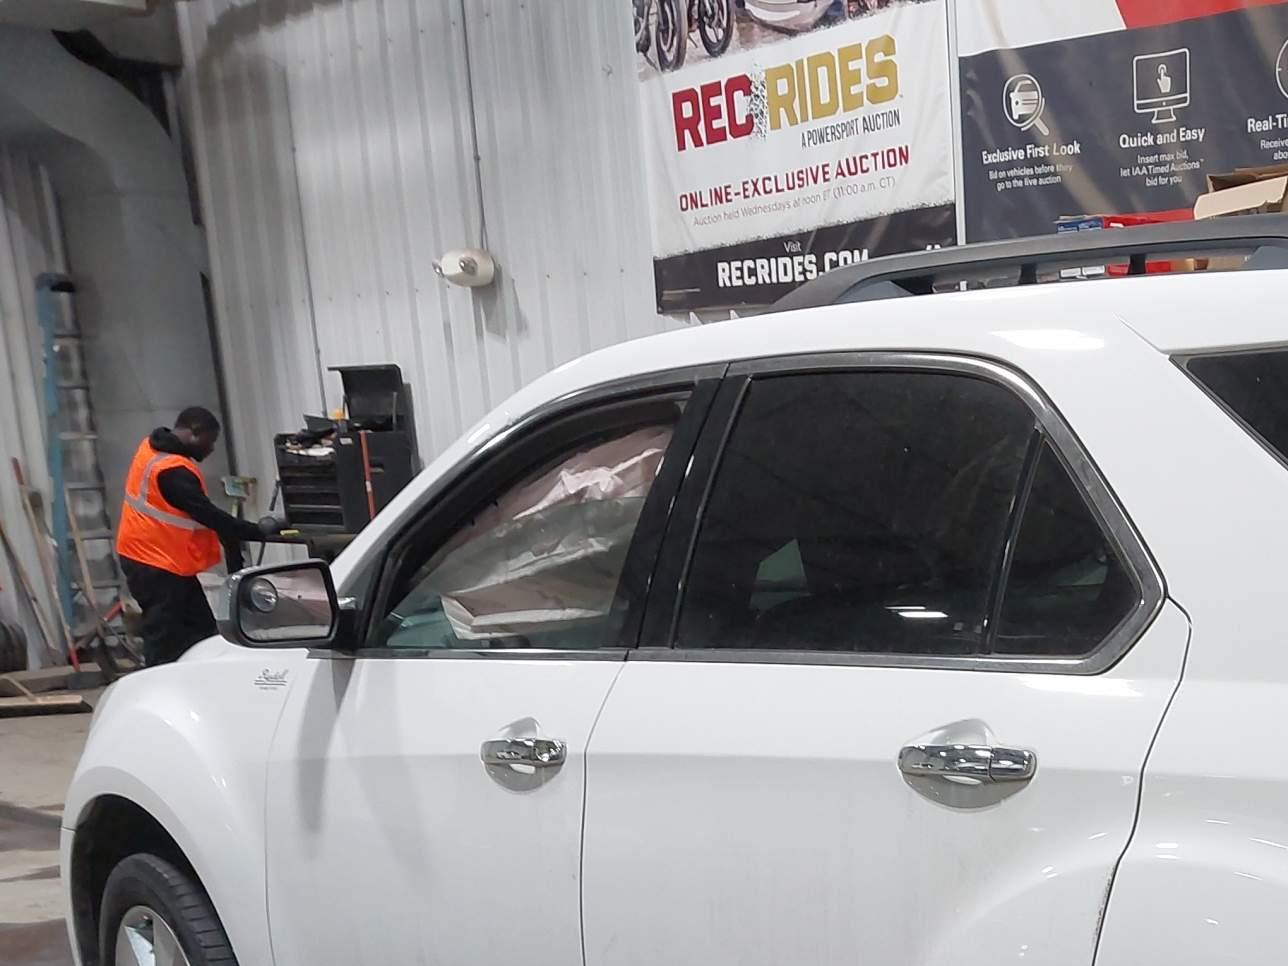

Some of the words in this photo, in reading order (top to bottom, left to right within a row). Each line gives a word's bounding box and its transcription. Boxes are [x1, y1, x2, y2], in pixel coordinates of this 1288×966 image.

[672, 73, 755, 152] REC
[763, 34, 899, 131] RIDES
[801, 132, 807, 148] A
[807, 118, 859, 146] POWERSPORT
[862, 109, 901, 134] AUCTION
[1119, 132, 1155, 149] Quick
[1156, 129, 1177, 145] and
[1179, 127, 1206, 143] Easy
[981, 147, 1025, 165] Exclusive
[1026, 144, 1050, 159] First
[1053, 140, 1081, 156] Look
[1137, 153, 1159, 164] Insert
[1160, 152, 1175, 161] max
[679, 163, 831, 213] ONLINE-EXCLUSIVE
[835, 145, 910, 180] AUCTION
[988, 169, 998, 180] Bid
[998, 170, 1007, 179] on
[1007, 165, 1034, 177] vehicles
[1035, 163, 1056, 174] before
[1120, 166, 1131, 177] let
[1132, 164, 1148, 176] IAA
[1147, 162, 1170, 174] Timed
[996, 181, 1005, 192] go
[1005, 180, 1013, 189] to
[1013, 178, 1023, 188] the
[1024, 176, 1038, 187] live
[1038, 174, 1062, 186] auction
[1145, 176, 1158, 187] bid
[1159, 175, 1168, 186] for
[1169, 175, 1183, 187] you
[693, 214, 721, 226] Auction
[723, 209, 740, 220] held
[741, 200, 792, 217] Wednesdays
[783, 241, 802, 254] Visit
